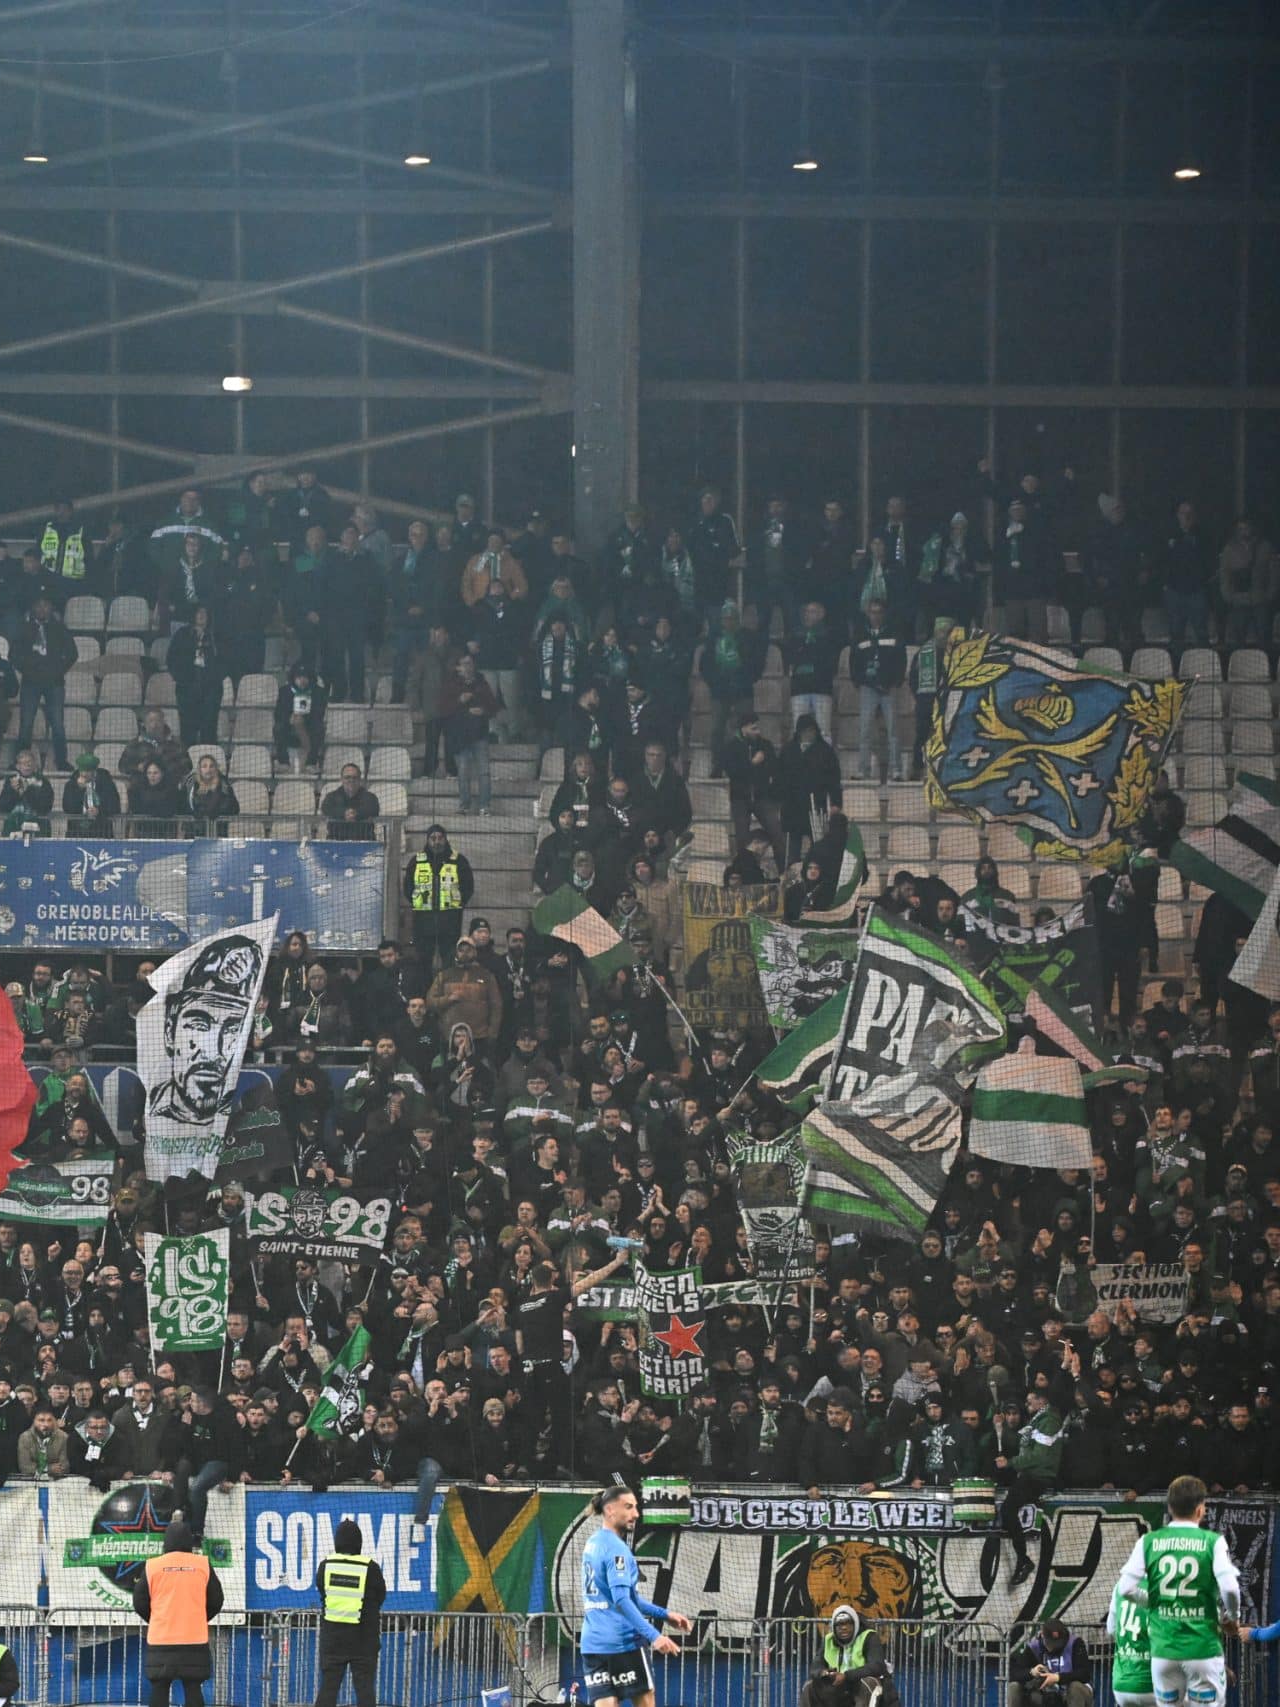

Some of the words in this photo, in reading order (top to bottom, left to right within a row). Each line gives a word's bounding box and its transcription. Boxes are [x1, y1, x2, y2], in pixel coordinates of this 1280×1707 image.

[55, 922, 150, 941] MÉTROPOLE
[71, 1176, 111, 1204] 98
[329, 1196, 391, 1241] 98
[258, 1241, 360, 1259] SAINT-ETIENNE
[1112, 1264, 1184, 1281] SECTION
[159, 1295, 225, 1338] 98
[832, 1502, 871, 1526] LE
[1222, 1509, 1266, 1525] ANGELS
[1158, 1555, 1199, 1597] 22
[1120, 1600, 1141, 1642] 14
